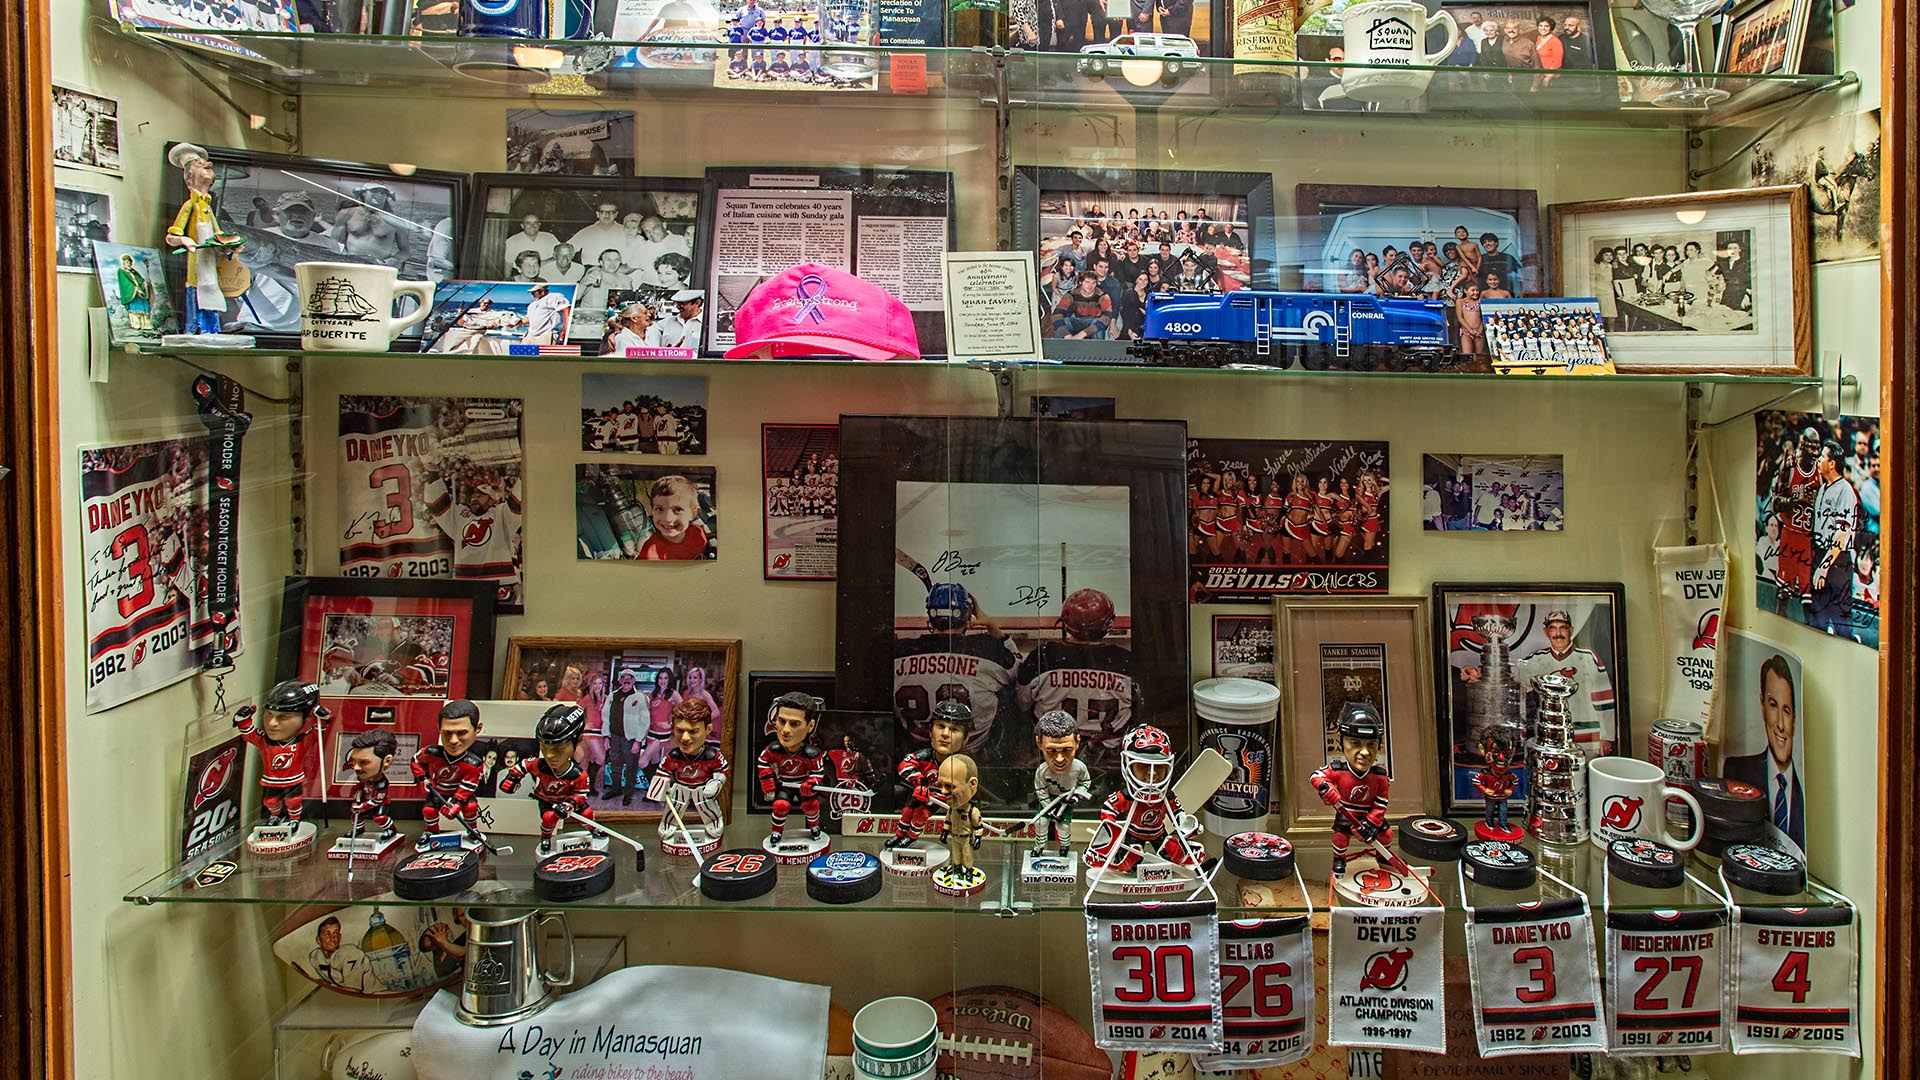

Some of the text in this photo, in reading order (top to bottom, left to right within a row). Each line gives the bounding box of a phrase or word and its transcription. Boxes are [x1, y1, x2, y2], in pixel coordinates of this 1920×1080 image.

[1377, 27, 1409, 37] SQUAN
[204, 39, 242, 54] LEAGUE
[1236, 36, 1277, 46] RISERVA
[1374, 38, 1411, 46] TAVERN
[726, 202, 748, 211] Squan
[757, 211, 781, 219] cuisine
[801, 212, 827, 220] Sunday
[1164, 322, 1201, 333] 4800
[222, 434, 234, 470] HOLDER
[346, 432, 430, 462] DANEYKO
[87, 482, 164, 534] DANEYKO
[369, 463, 414, 539] 3
[1792, 504, 1814, 532] 23
[216, 497, 231, 603] SEASON TICKET HOLDER
[111, 523, 155, 619] 3
[408, 558, 449, 577] 2003
[1675, 571, 1702, 581] NEW
[1205, 572, 1378, 593] DEVILS DANCERS
[89, 620, 188, 688] 1982 2003
[1323, 648, 1379, 656] YANKEE STADIUM
[896, 655, 979, 677] J.BOSSONE
[1050, 671, 1125, 693] D.BOSSONE
[841, 793, 860, 807] 26
[1243, 784, 1259, 799] CUP
[878, 819, 898, 833] NE
[187, 825, 235, 860] SEASONS
[441, 841, 459, 849] pepsi
[663, 842, 718, 856] CORY SCHEIDER
[709, 853, 765, 873] 26
[1045, 875, 1074, 883] DOWD
[1155, 883, 1185, 892] BRODEUR
[1353, 916, 1422, 925] NEW JERSEY
[1111, 923, 1191, 941] BRODEUR
[1357, 927, 1417, 942] DEVILS
[1493, 922, 1571, 945] DANEYKO
[1757, 929, 1835, 948] STEVENS
[1225, 943, 1274, 960] ELIAS
[1621, 933, 1714, 953] NIEDERMAYER
[1113, 945, 1195, 1002] 30
[1513, 945, 1558, 1003] 3
[1771, 951, 1811, 1003] 4
[1219, 962, 1293, 1018] 26
[1633, 955, 1703, 1010] 27
[1339, 996, 1433, 1010] ATLANTIC DIVISION
[1355, 1009, 1418, 1022] CHAMPIONS
[1108, 1025, 1207, 1040] 1990 2014
[1362, 1027, 1412, 1038] 1996-1997
[1490, 1025, 1591, 1042] 1982 2003
[1621, 1031, 1713, 1045] 1991 2004
[1747, 1025, 1844, 1041] 1991 2005
[498, 1024, 702, 1060] A Day in Manasquan
[1268, 1036, 1300, 1053] 2016
[572, 1064, 695, 1080] riding bikes to the beach
[1466, 1064, 1514, 1076] FAMILY
[1519, 1064, 1559, 1076] SINCE
